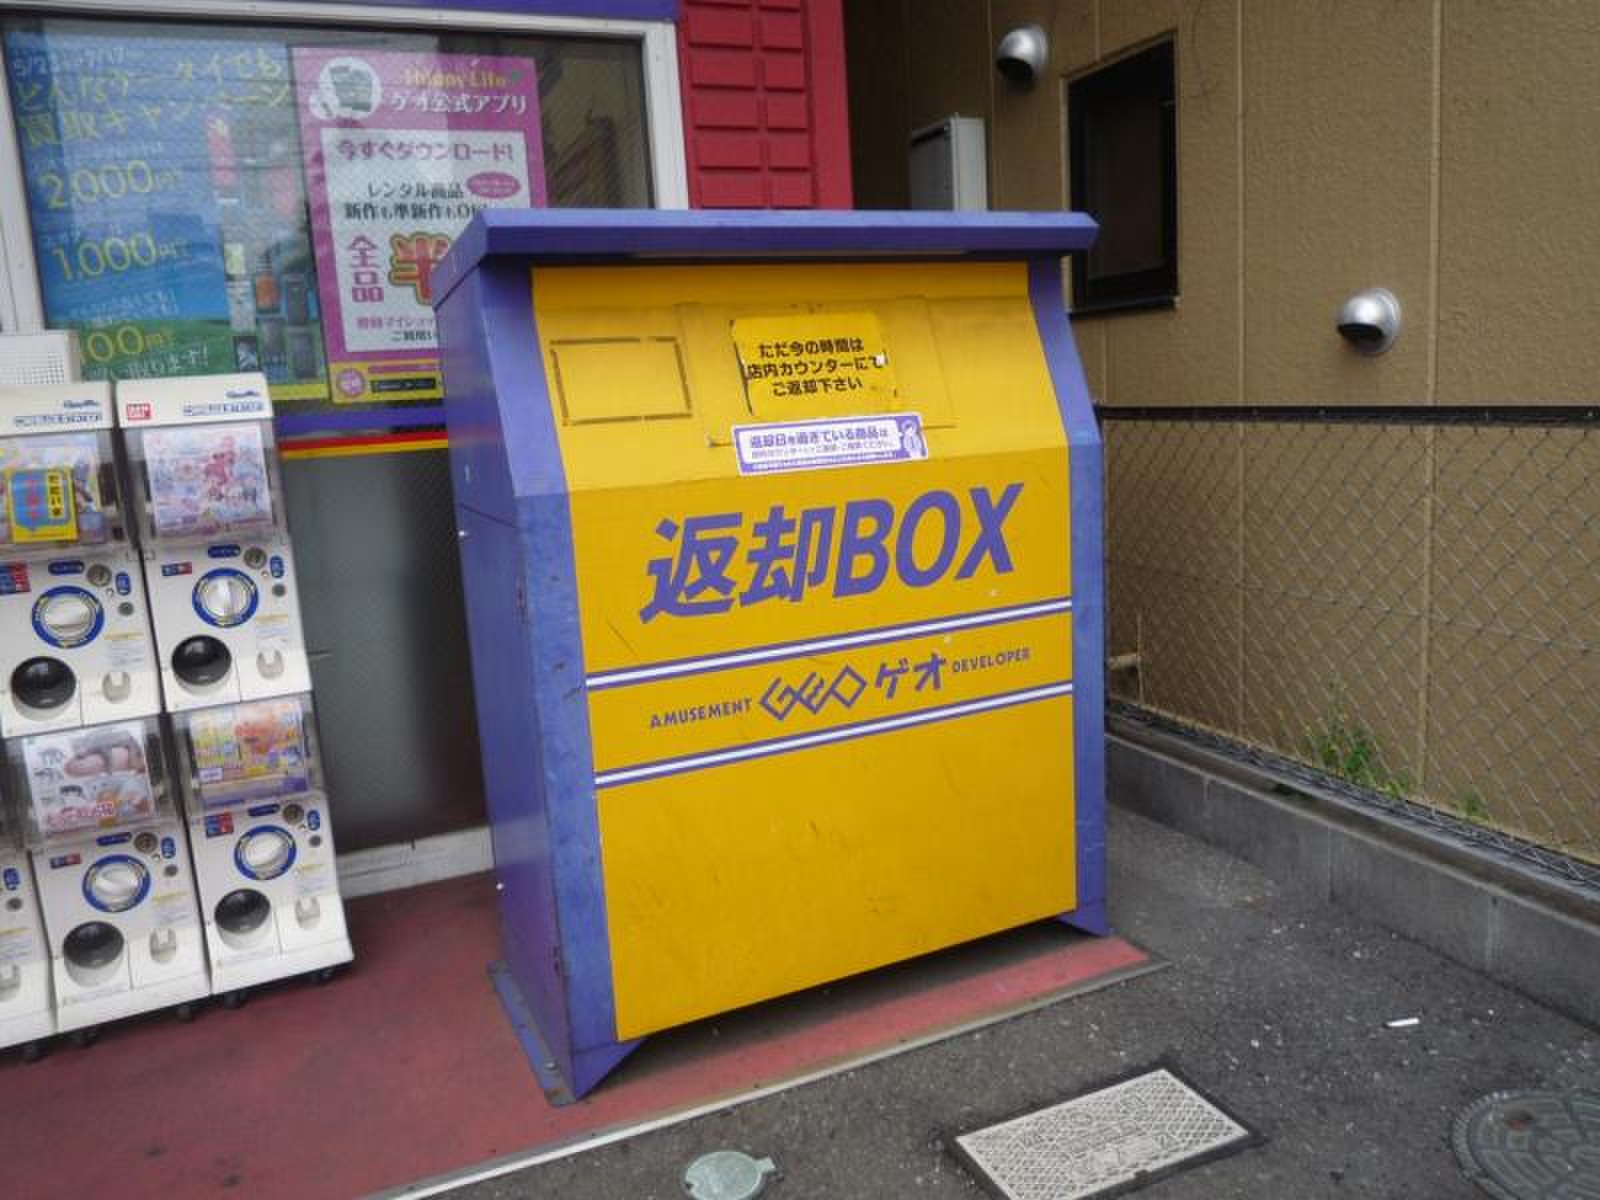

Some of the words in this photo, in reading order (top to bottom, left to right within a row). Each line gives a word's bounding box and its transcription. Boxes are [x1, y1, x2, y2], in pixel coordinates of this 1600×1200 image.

[348, 234, 385, 303] 全品
[747, 354, 886, 381] 店内カウンターにて
[758, 336, 864, 359] ただ今の時間は
[771, 375, 864, 398] ご返却下さい
[639, 482, 1025, 625] 返却BOX
[649, 697, 753, 729] AMUSEMENT
[758, 663, 869, 721] GEO
[874, 651, 947, 699] ゲオ
[951, 646, 1032, 674] DEVELOPER
